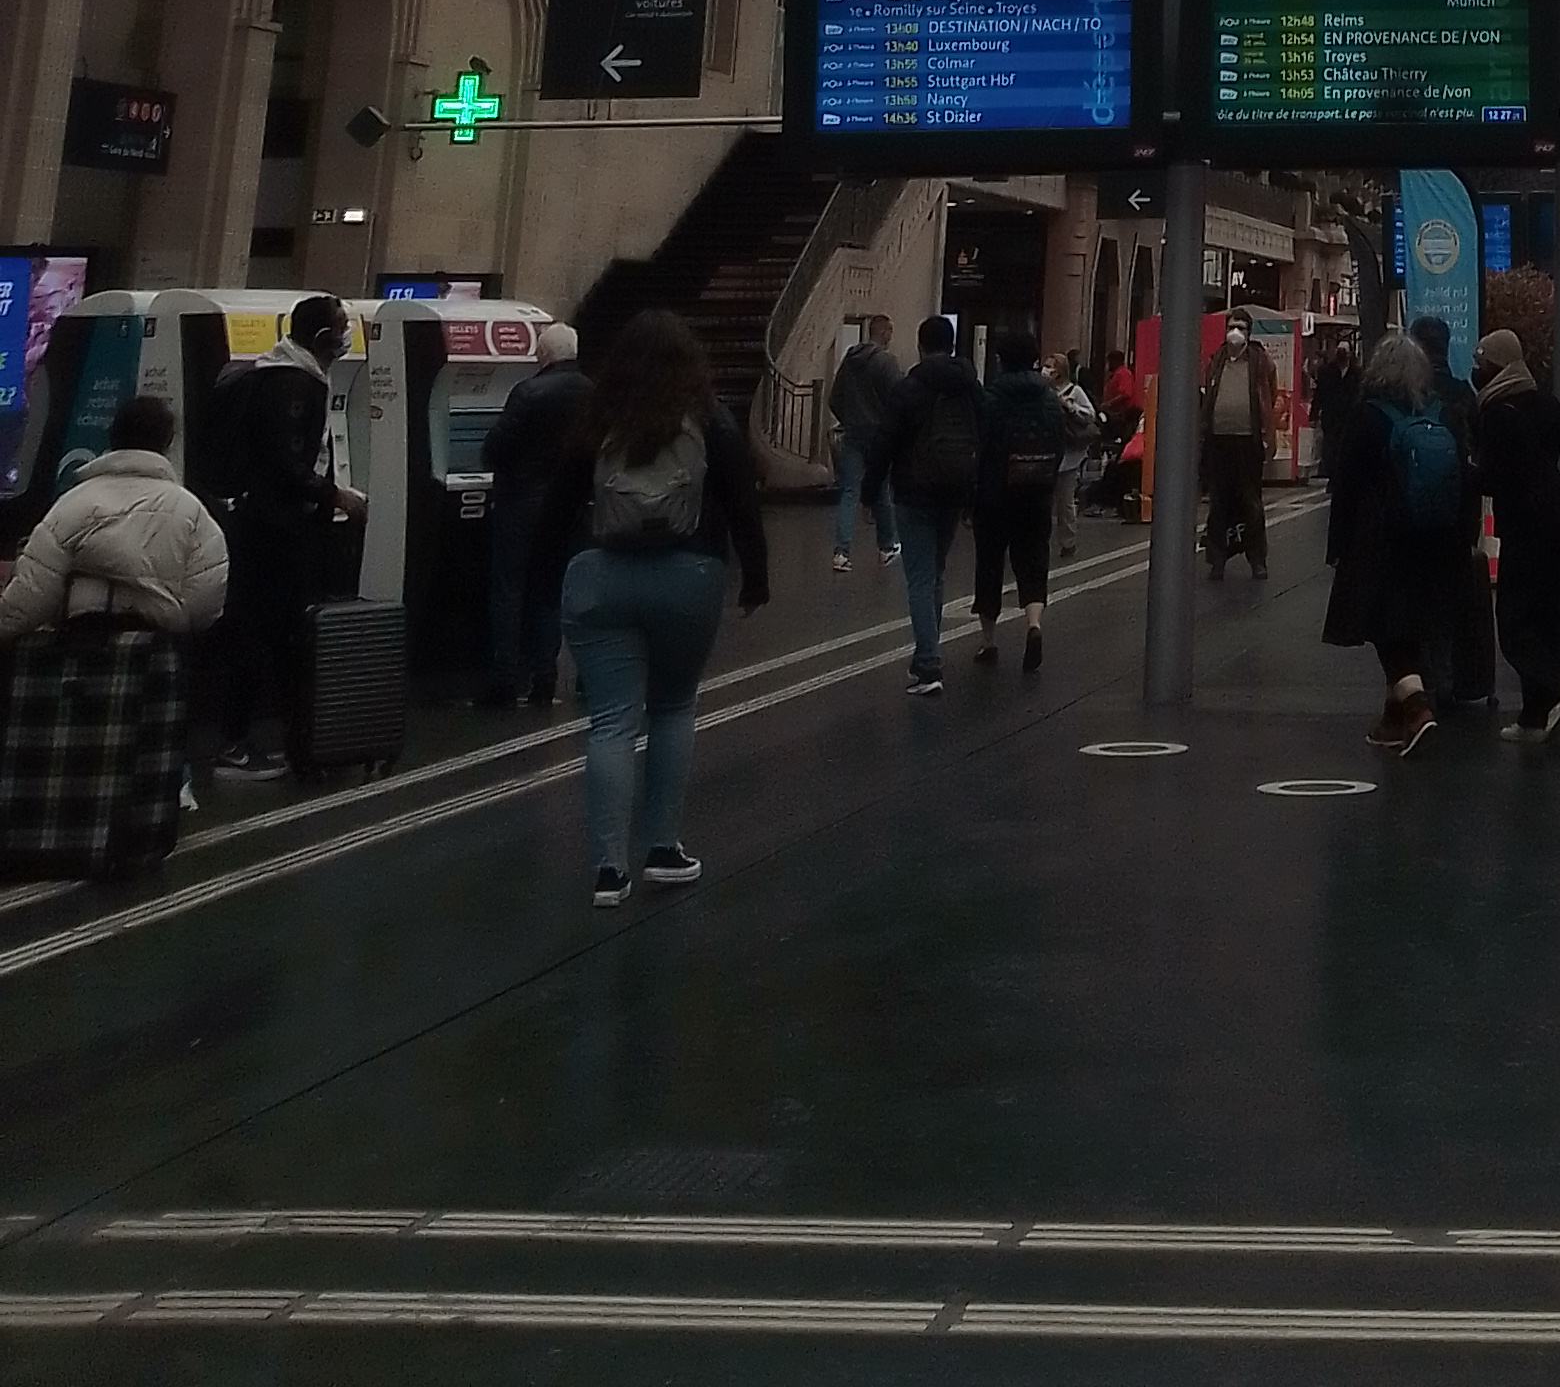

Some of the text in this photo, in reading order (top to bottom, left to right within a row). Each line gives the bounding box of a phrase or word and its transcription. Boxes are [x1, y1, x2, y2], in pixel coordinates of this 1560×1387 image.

[873, 3, 1038, 18] Romilly sur Seine Troyes
[928, 19, 1022, 35] DESTINATION
[1031, 18, 1073, 33] NACH
[1081, 17, 1103, 32] TO
[1280, 13, 1365, 28] 12h48 Reims
[927, 38, 1011, 55] Luxembourg
[1280, 32, 1316, 47] 12h54
[1324, 31, 1344, 46] EN
[1346, 30, 1438, 46] PROVENANCE
[1441, 30, 1460, 45] DE
[1469, 29, 1502, 45] VON
[926, 57, 977, 71] Colmar
[1280, 49, 1368, 65] 13h16 Troyes
[926, 74, 988, 91] Stuttgart
[990, 73, 1017, 87] Hbf
[1280, 66, 1429, 84] 13h53 Château Thierry
[926, 92, 969, 109] Nancy
[1279, 86, 1316, 101] 14h05
[1324, 86, 1342, 101] En
[1344, 87, 1421, 104] provenance
[1423, 85, 1441, 100] de
[926, 110, 941, 124] St
[944, 109, 983, 124] Dizier
[1235, 107, 1251, 120] du
[1251, 107, 1273, 120] titre
[1275, 107, 1289, 120] de
[1343, 107, 1358, 120] Le
